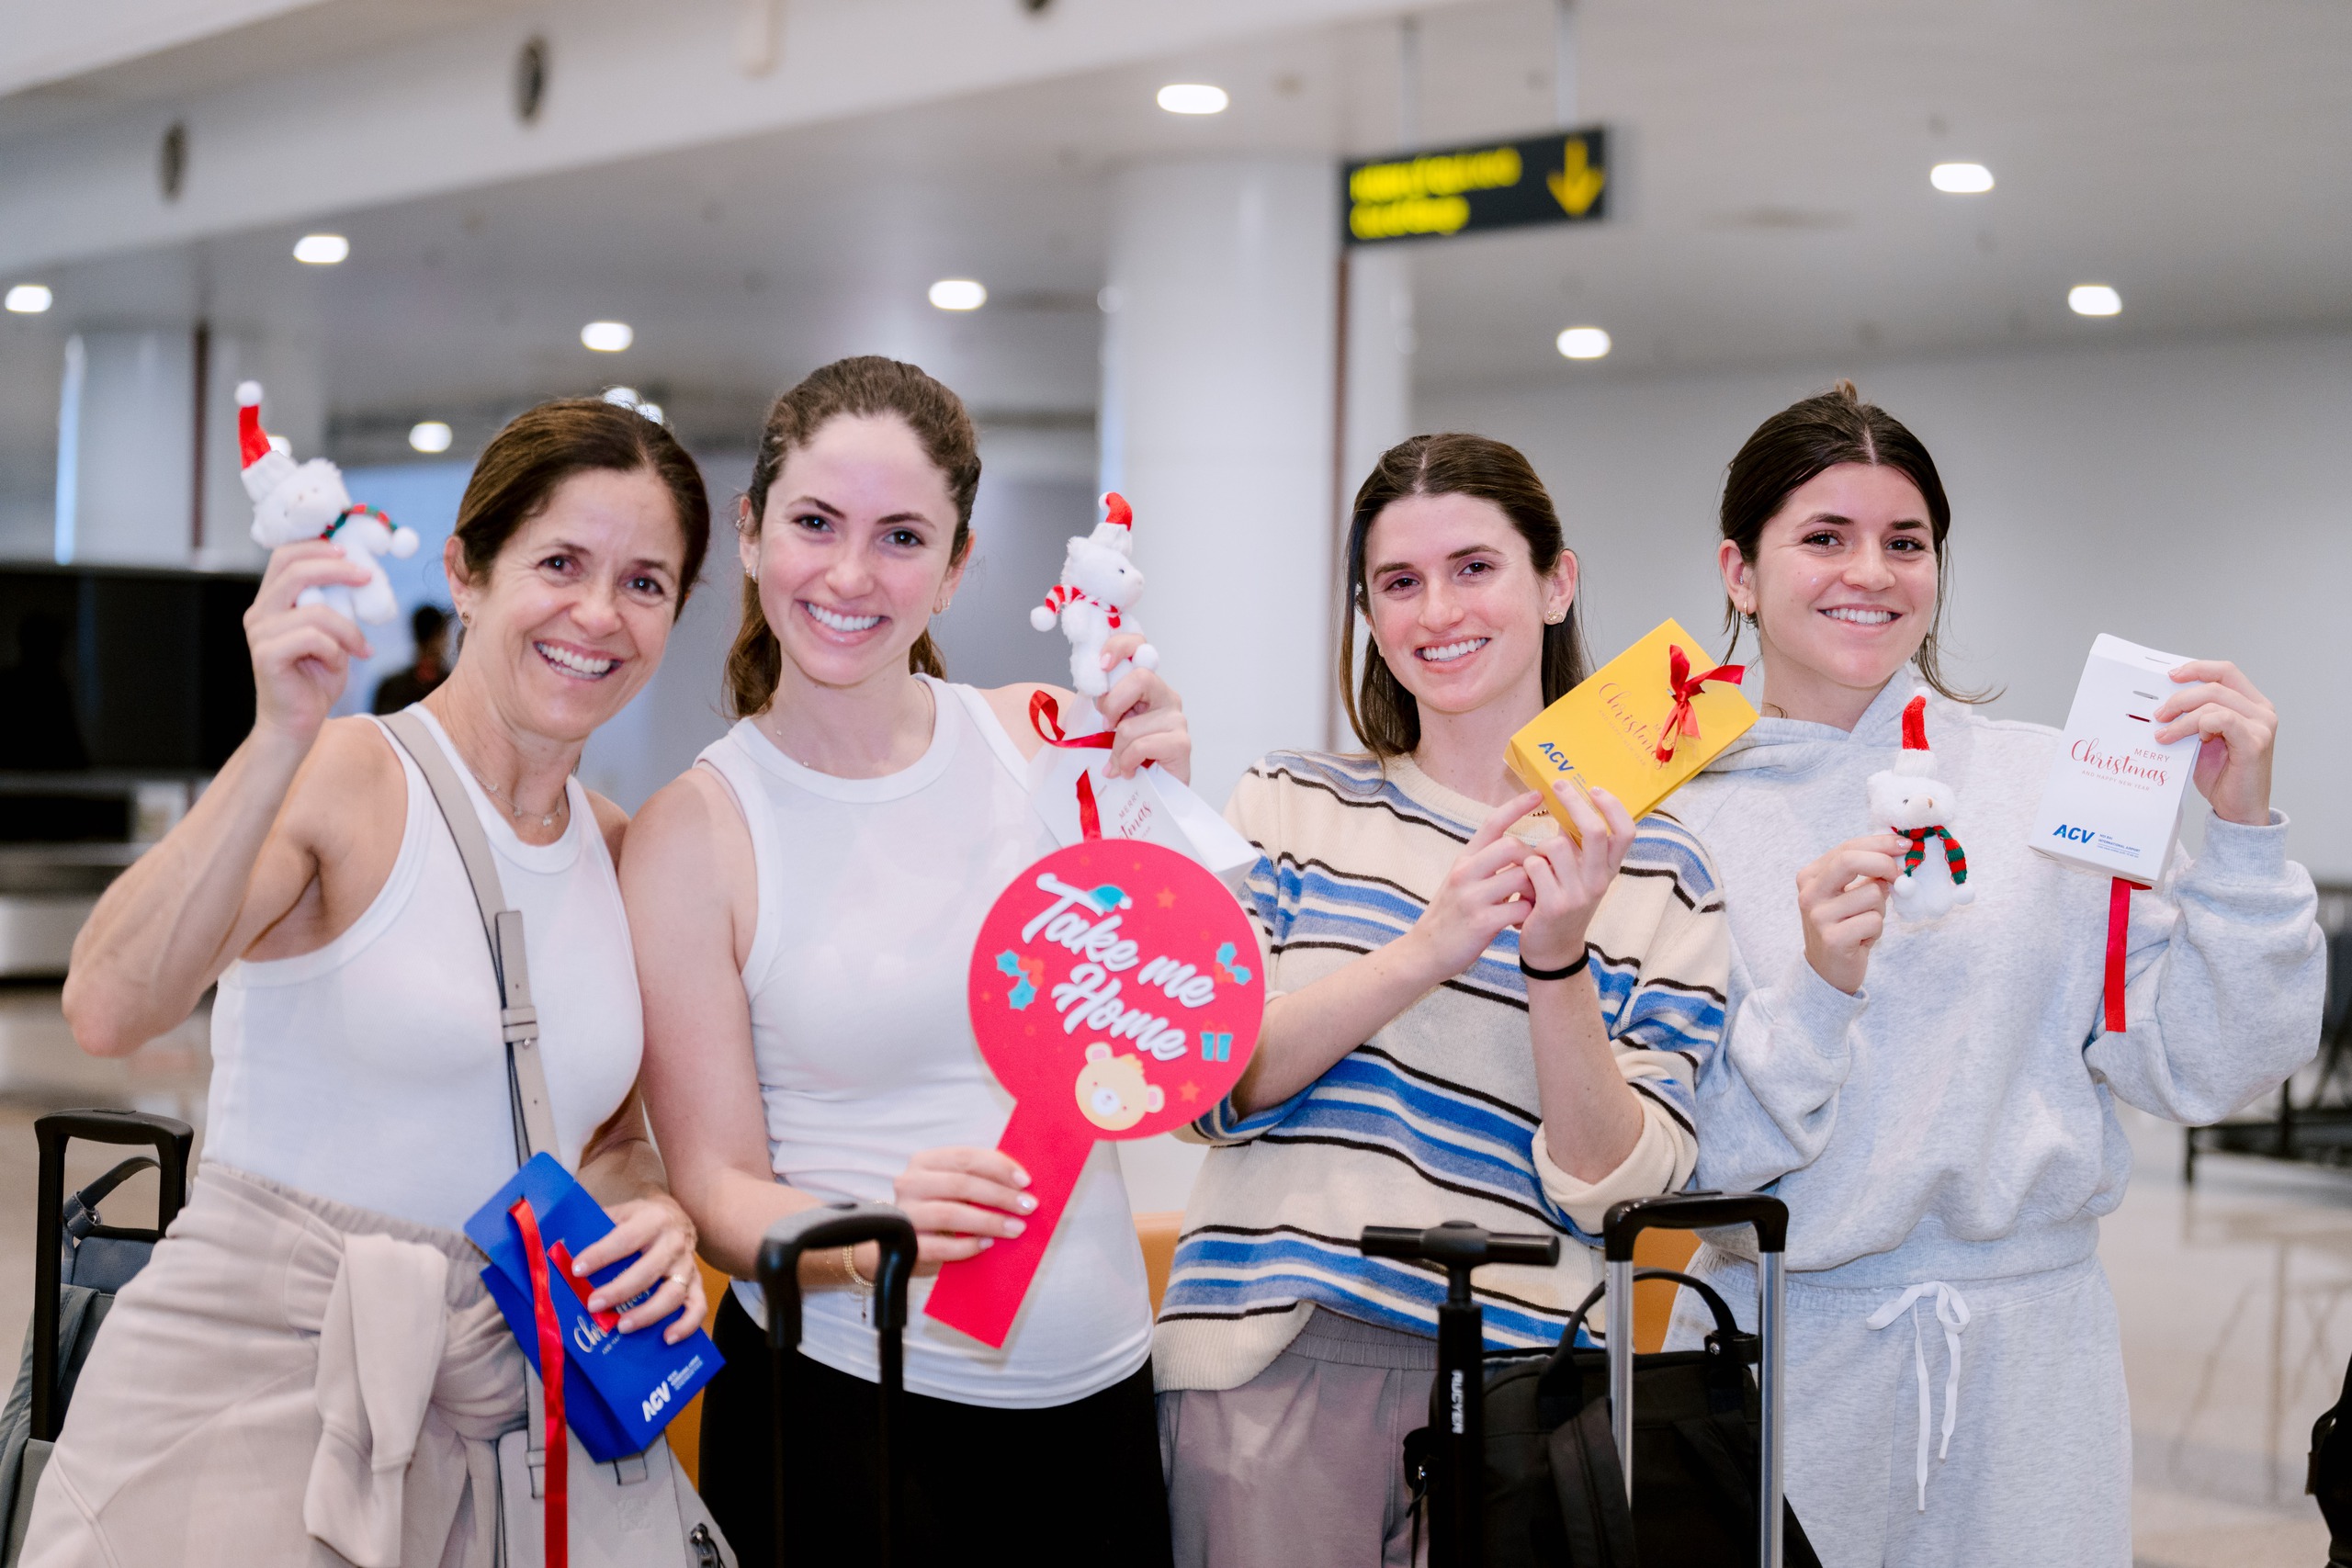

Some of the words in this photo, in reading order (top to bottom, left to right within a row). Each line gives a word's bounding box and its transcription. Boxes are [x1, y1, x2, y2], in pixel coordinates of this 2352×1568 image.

[1653, 723, 1681, 752] MRRY
[1537, 742, 1575, 772] ACV
[2071, 737, 2170, 786] Christmas
[2134, 748, 2170, 762] MERRY
[2097, 773, 2117, 783] HAPPY
[2119, 779, 2133, 787] NEW
[1118, 789, 1138, 818] MERRY
[2052, 824, 2096, 844] ACV
[1022, 873, 1139, 972] Take
[1137, 955, 1216, 1008] me
[1051, 963, 1187, 1061] Home
[642, 1381, 672, 1422] ACV
